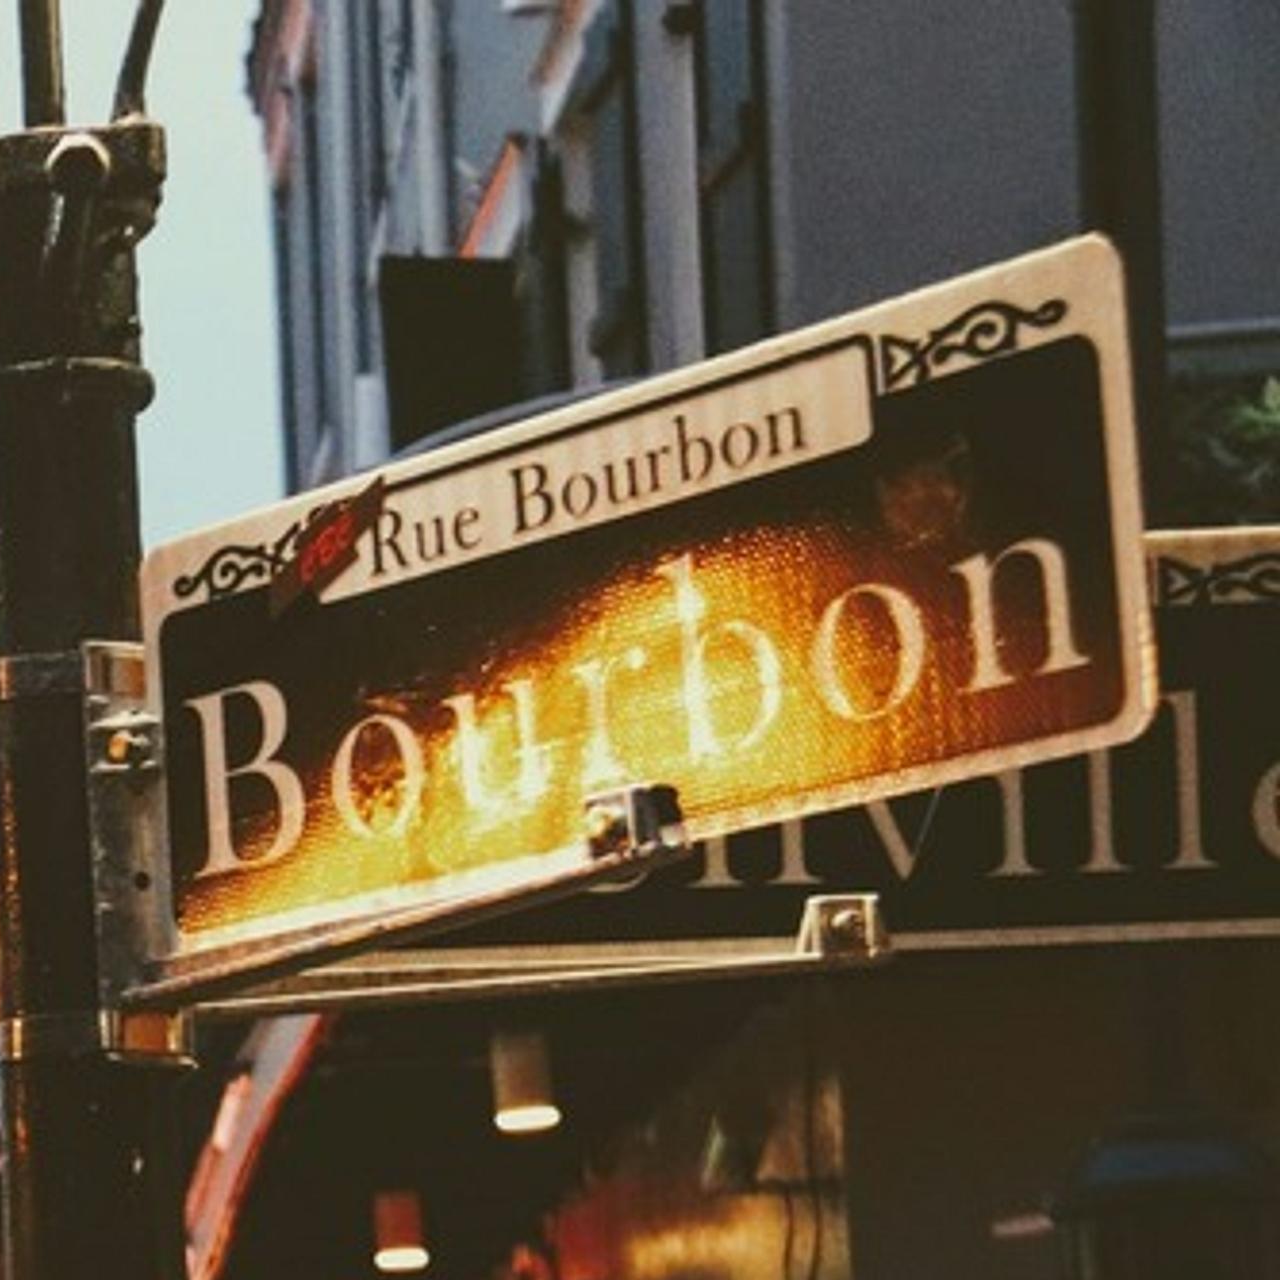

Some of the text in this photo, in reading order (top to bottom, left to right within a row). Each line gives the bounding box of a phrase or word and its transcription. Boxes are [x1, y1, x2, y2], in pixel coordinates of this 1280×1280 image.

[369, 505, 483, 577] Rue
[508, 405, 808, 536] Bourbon
[183, 534, 1093, 882] Bourbon
